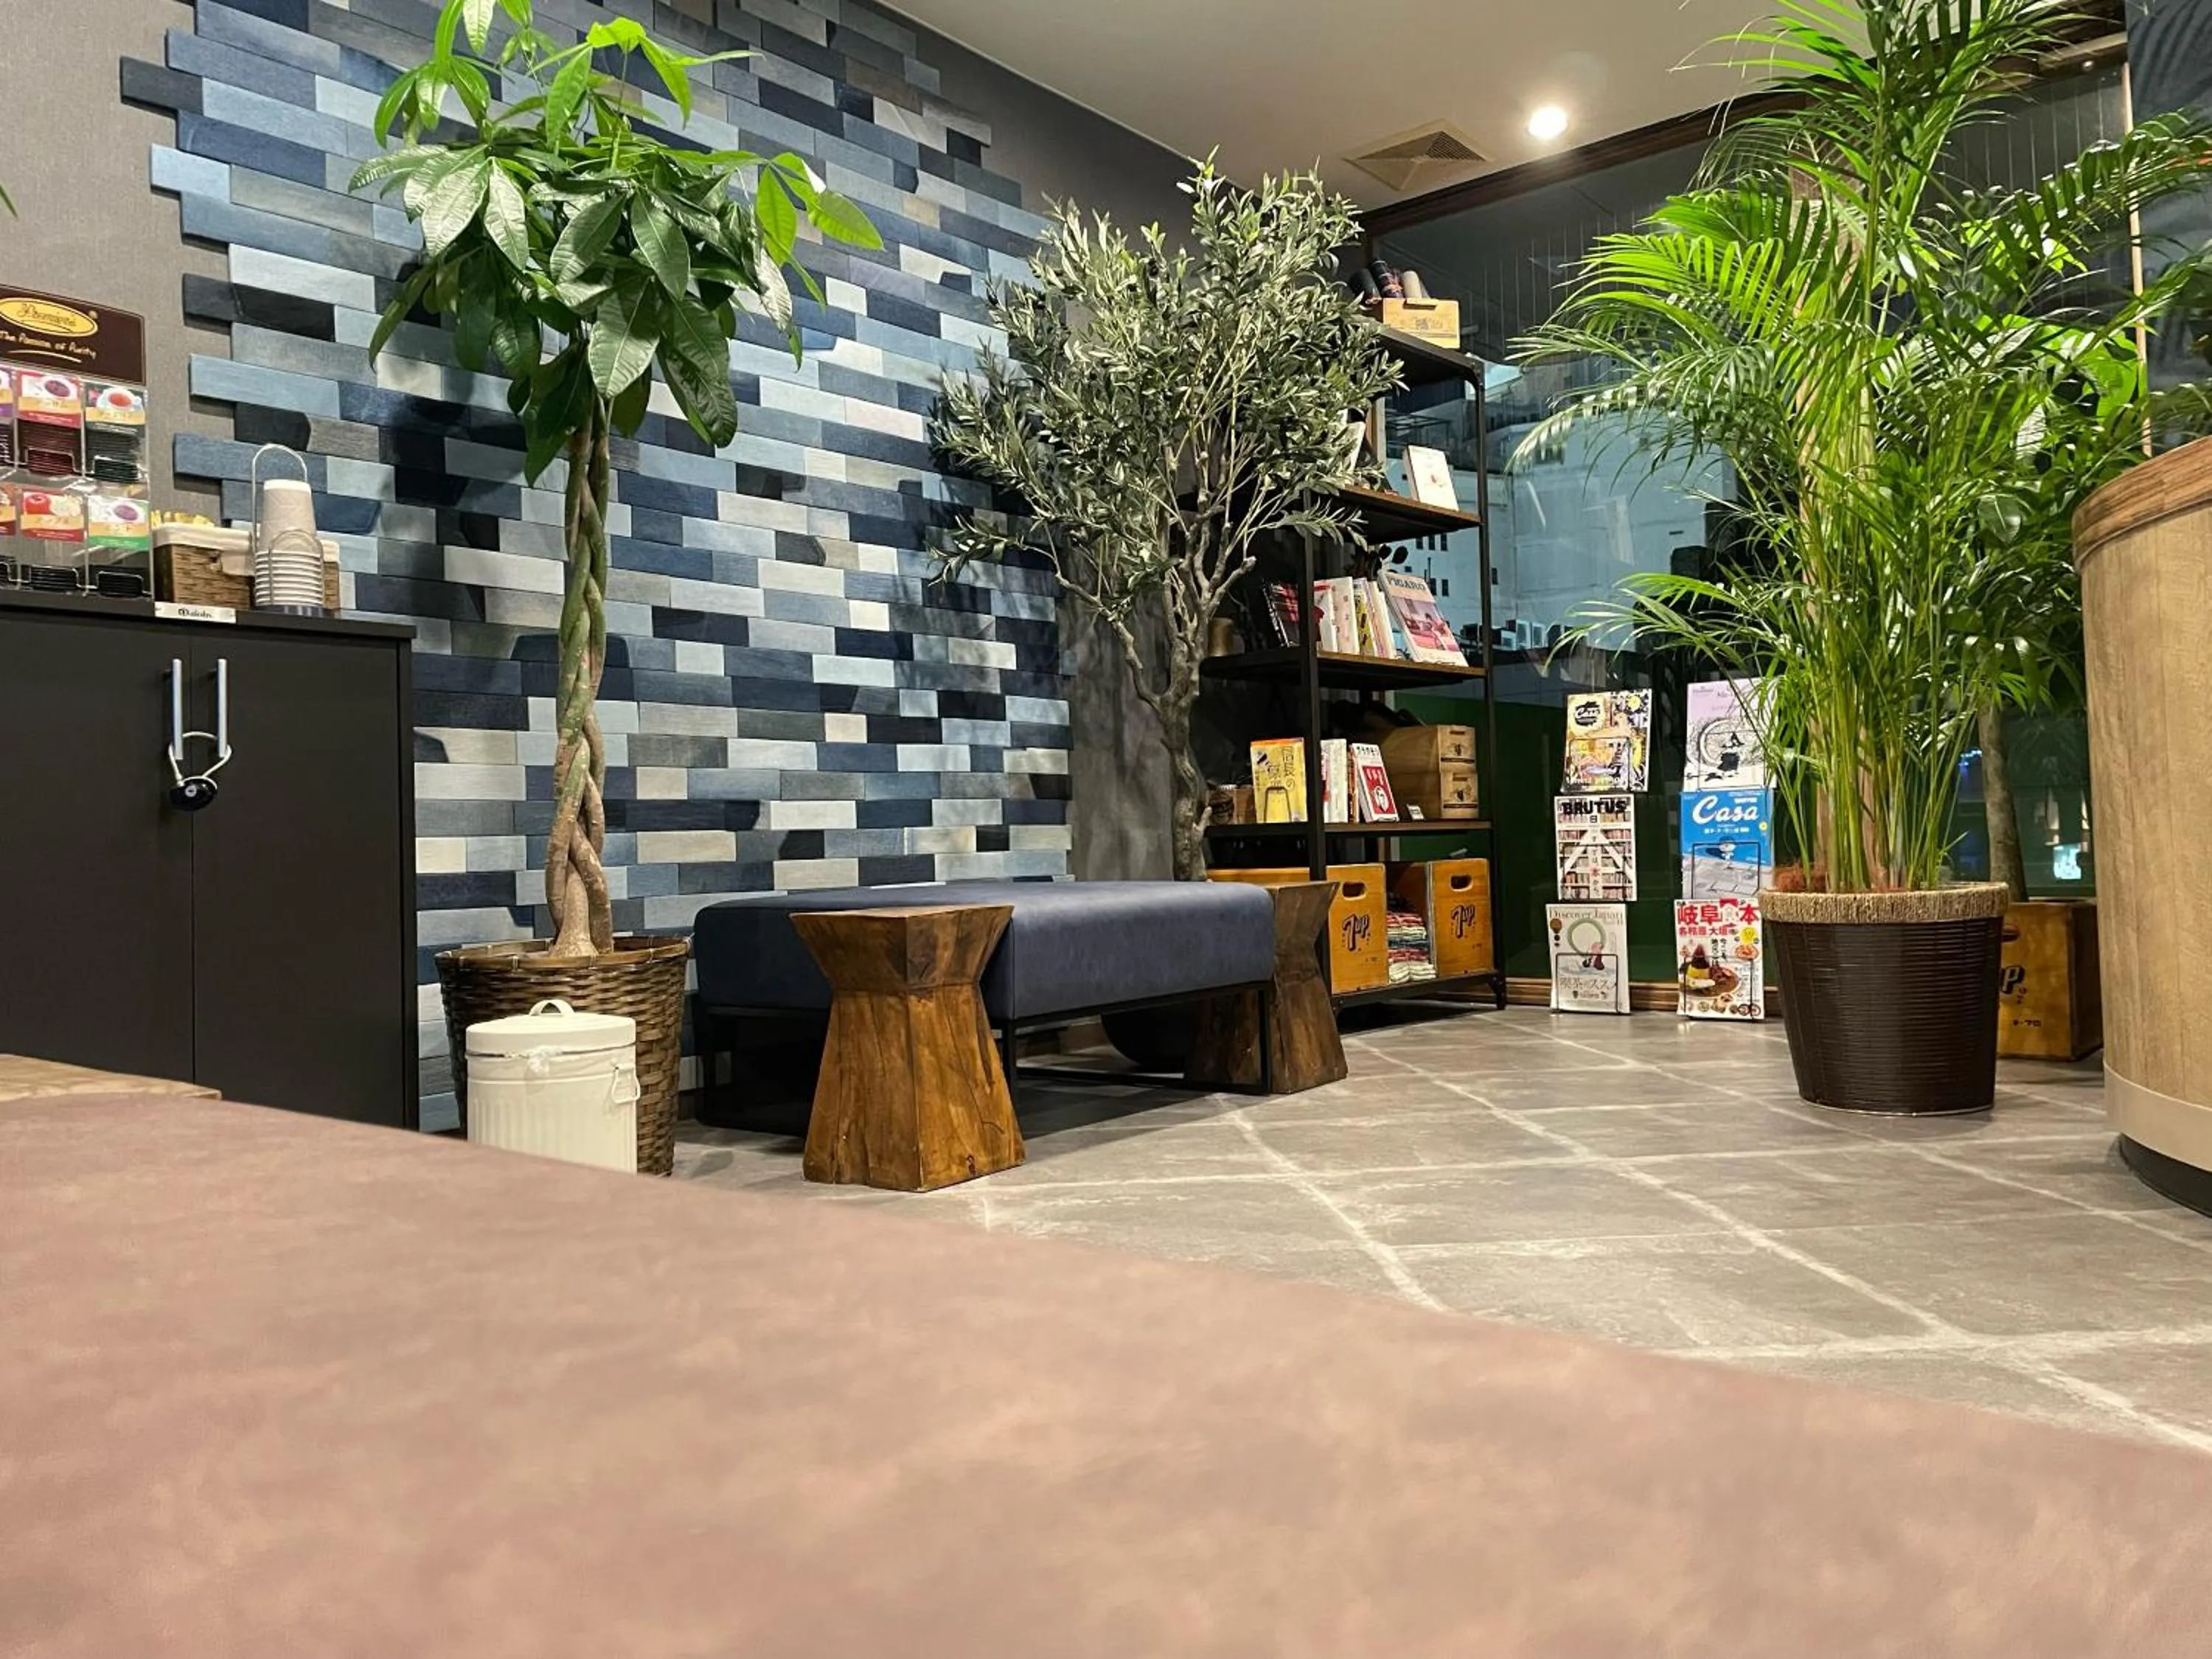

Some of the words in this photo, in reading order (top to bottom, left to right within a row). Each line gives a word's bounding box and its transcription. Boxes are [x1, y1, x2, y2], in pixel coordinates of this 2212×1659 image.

[55, 342, 67, 350] of
[1562, 800, 1627, 815] BRUTUS
[1692, 795, 1759, 824] Casa
